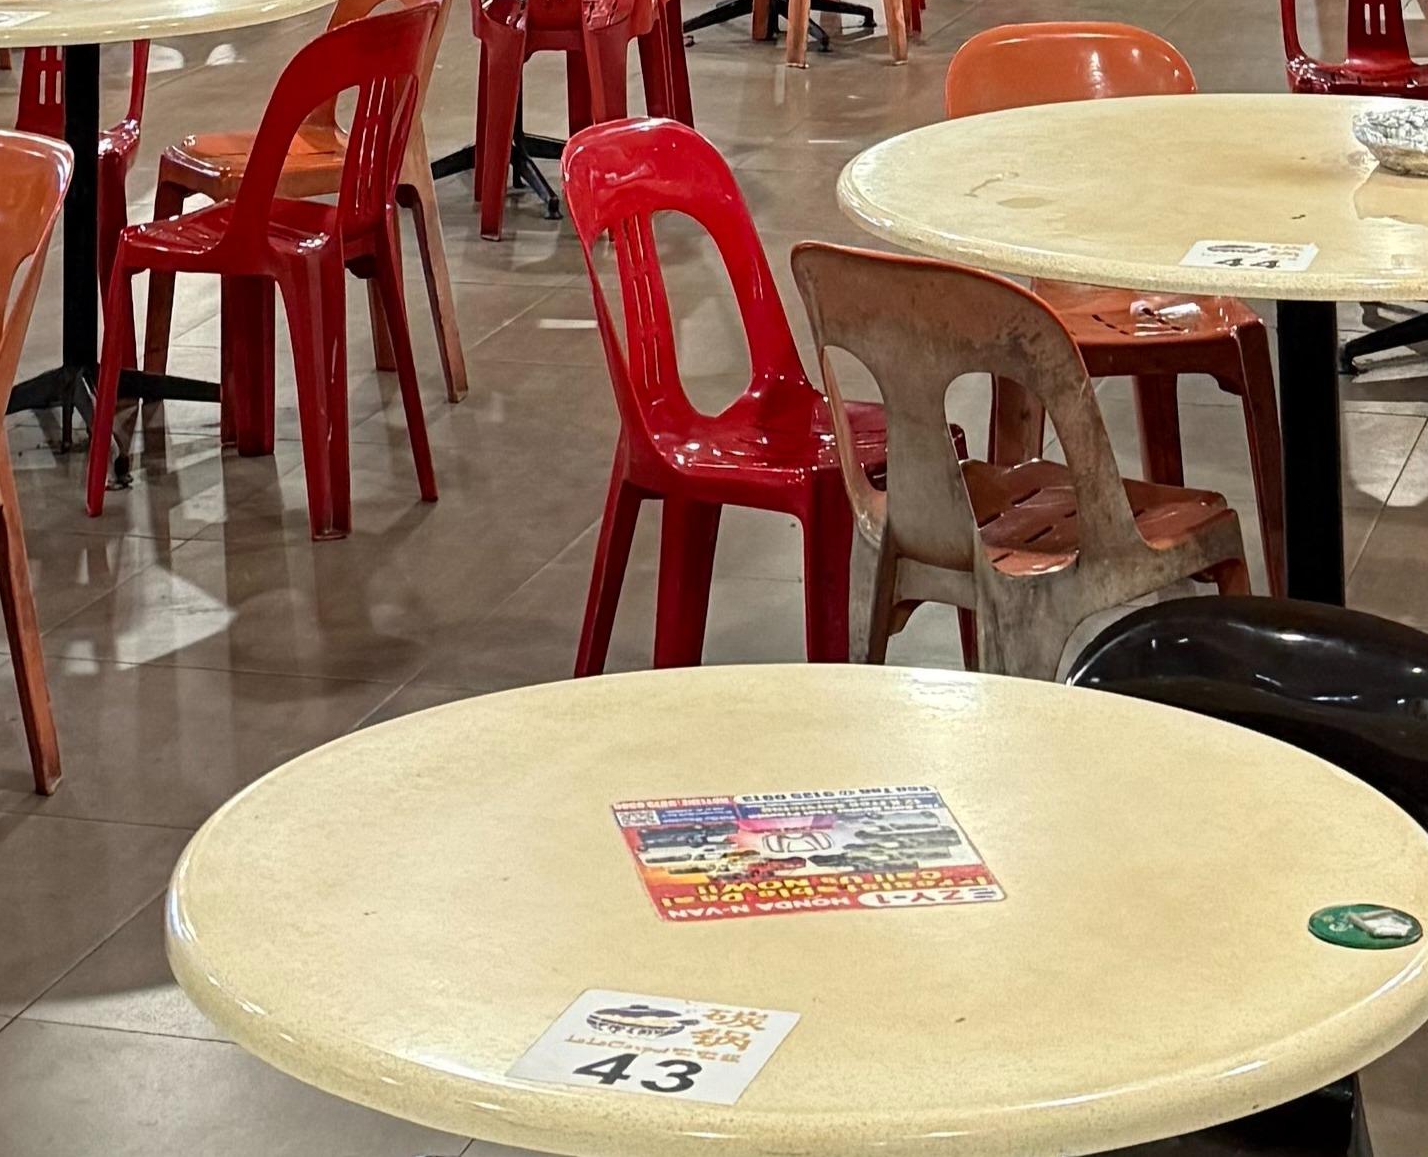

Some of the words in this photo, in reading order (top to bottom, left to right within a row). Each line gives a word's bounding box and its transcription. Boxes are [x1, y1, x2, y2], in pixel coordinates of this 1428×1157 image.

[1214, 258, 1280, 269] 44
[820, 874, 863, 886] Us
[883, 870, 943, 883] Call
[661, 892, 747, 908] Deal
[756, 896, 851, 911] HONDA
[667, 903, 750, 920] N-VAN
[572, 1053, 704, 1093] 43
